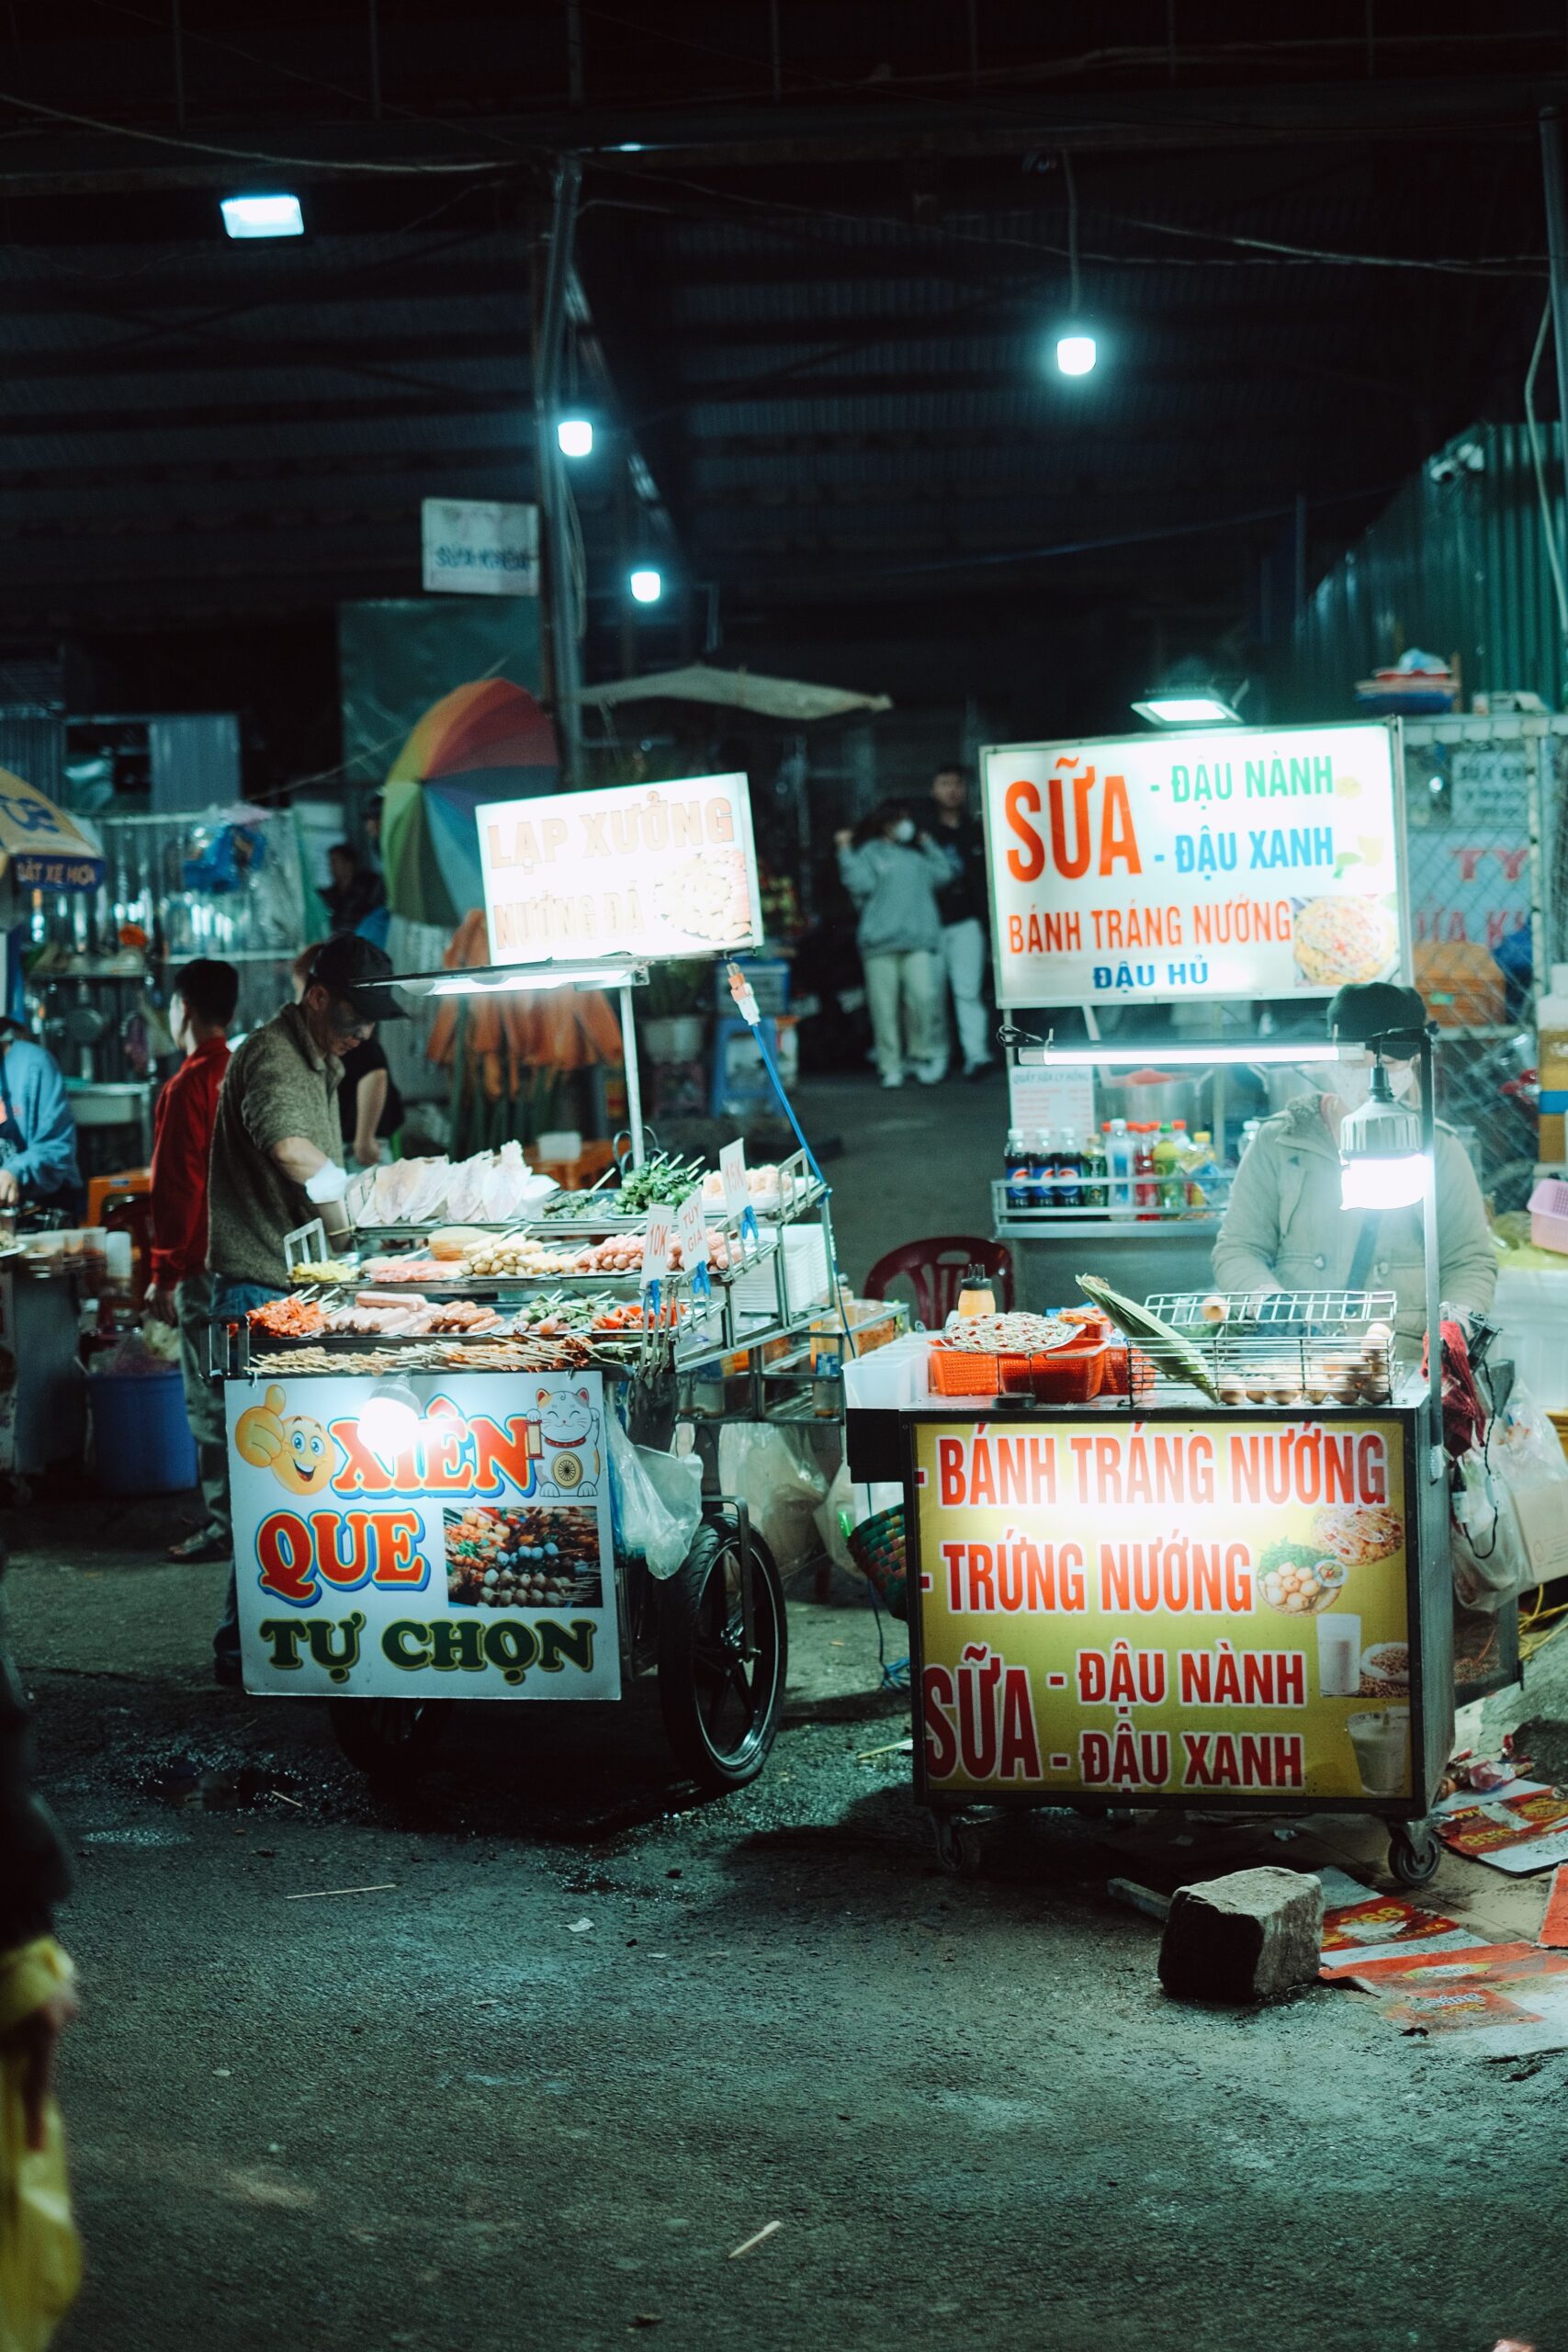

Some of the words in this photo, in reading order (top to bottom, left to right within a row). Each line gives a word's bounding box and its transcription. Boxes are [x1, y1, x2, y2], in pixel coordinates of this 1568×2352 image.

[1171, 755, 1233, 810] ĐẬU
[1246, 751, 1334, 798] NÀNH
[487, 817, 569, 876] LẠP
[579, 790, 736, 858] XƯỞNG
[1004, 756, 1143, 883] SỮA
[1175, 825, 1238, 881] ĐẬU
[1249, 826, 1334, 869] XANH
[493, 889, 597, 950] NƯỚNG
[1009, 903, 1082, 955] BÁNH
[1091, 899, 1183, 950] TRÁNG
[1193, 893, 1292, 944] NƯỚNG
[1093, 961, 1156, 993] ĐẬU
[649, 1223, 669, 1257] 10K
[938, 1422, 1057, 1507] BÁNH
[1071, 1422, 1215, 1505] TRÁNG
[1231, 1422, 1387, 1505] NƯỚNG
[255, 1508, 432, 1609] QUE
[942, 1529, 1087, 1612] TRỨNG
[1101, 1529, 1254, 1612] NƯỚNG
[259, 1610, 367, 1683] TỰ
[380, 1619, 597, 1686] CHỌN
[1078, 1642, 1166, 1714] ĐẬU
[1181, 1643, 1305, 1705] NÀNH
[924, 1645, 1042, 1780] SỮA
[1081, 1724, 1169, 1793] ĐẬU
[1183, 1734, 1303, 1787] XANH
